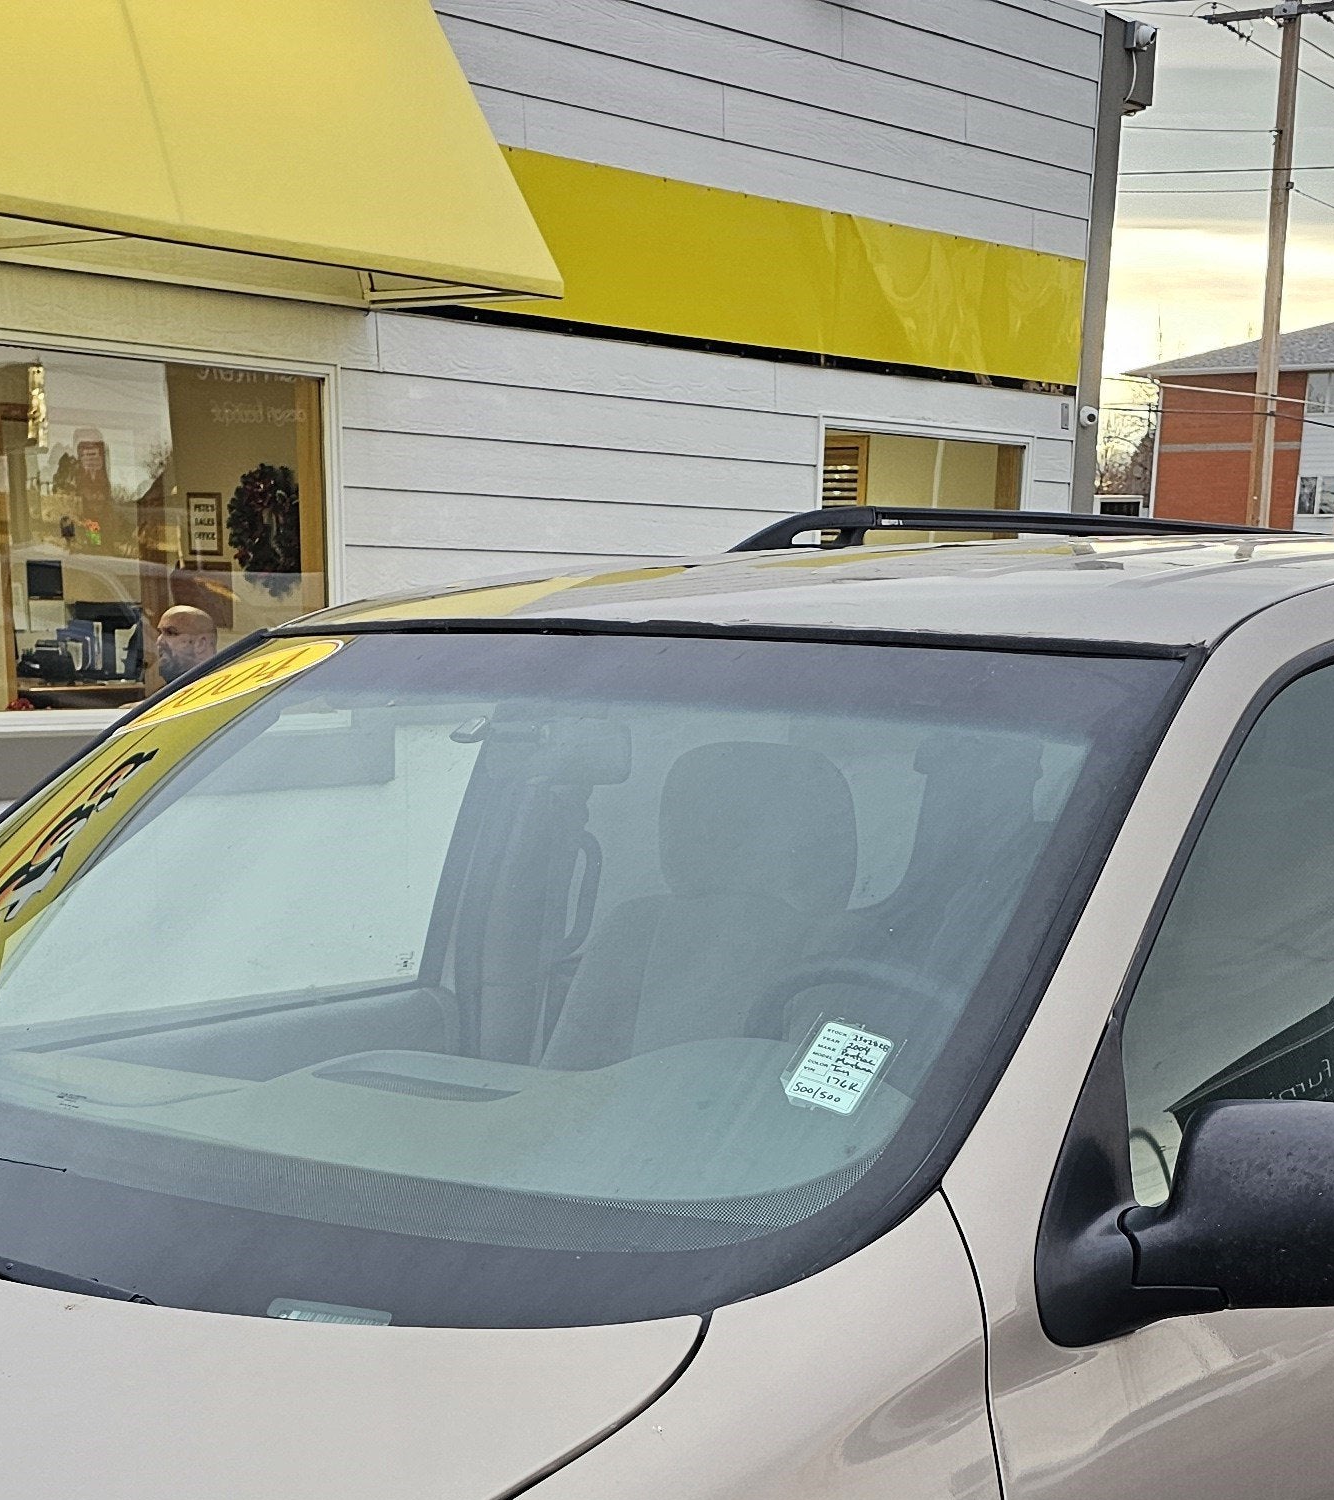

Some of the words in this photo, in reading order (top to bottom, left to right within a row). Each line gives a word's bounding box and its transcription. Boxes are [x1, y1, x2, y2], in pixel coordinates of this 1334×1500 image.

[847, 1042, 871, 1055] 2004
[807, 1059, 828, 1067] COLOR
[793, 1082, 841, 1103] 500/500
